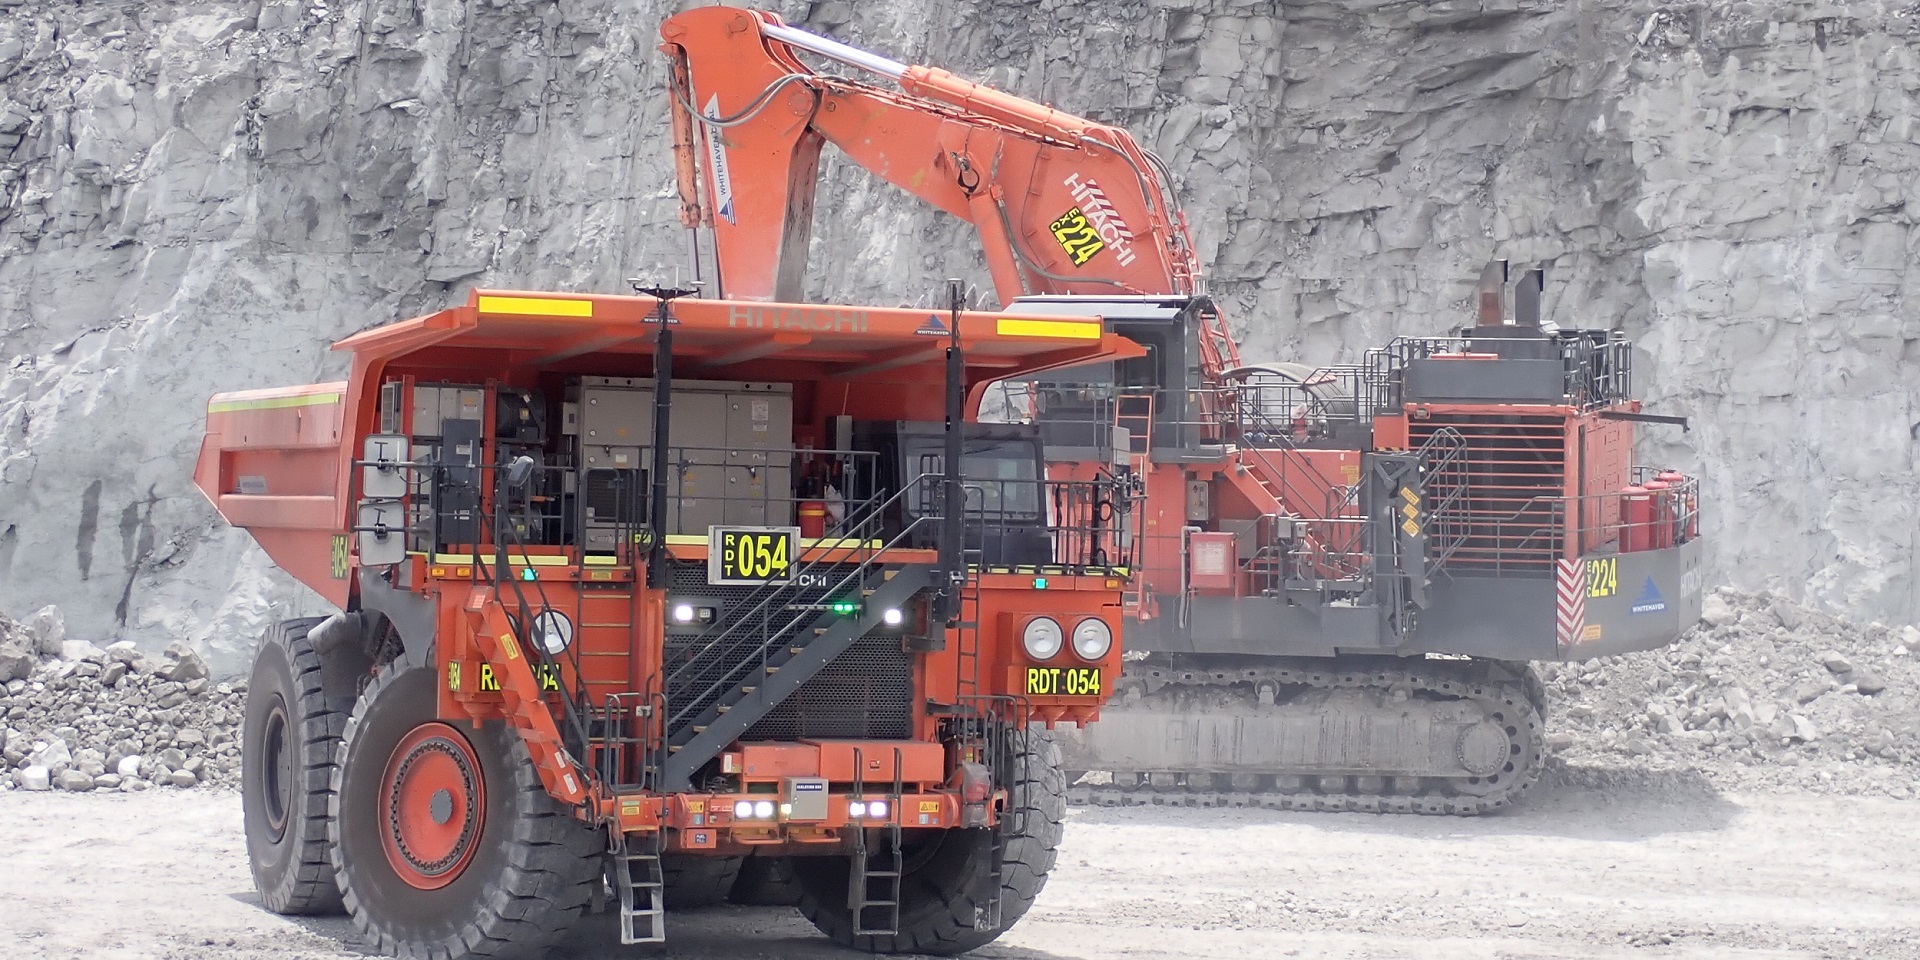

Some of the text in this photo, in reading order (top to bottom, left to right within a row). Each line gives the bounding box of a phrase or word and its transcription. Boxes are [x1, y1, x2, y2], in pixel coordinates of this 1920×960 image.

[710, 109, 726, 195] WHITEHAVEN CAL
[1063, 172, 1136, 267] HITACHI
[1055, 216, 1103, 265] 224
[729, 304, 867, 333] HITACHI
[738, 534, 788, 577] 054
[1591, 557, 1617, 597] 224
[1632, 603, 1665, 613] WHITEHAVEN
[1027, 668, 1100, 695] RDT 054
